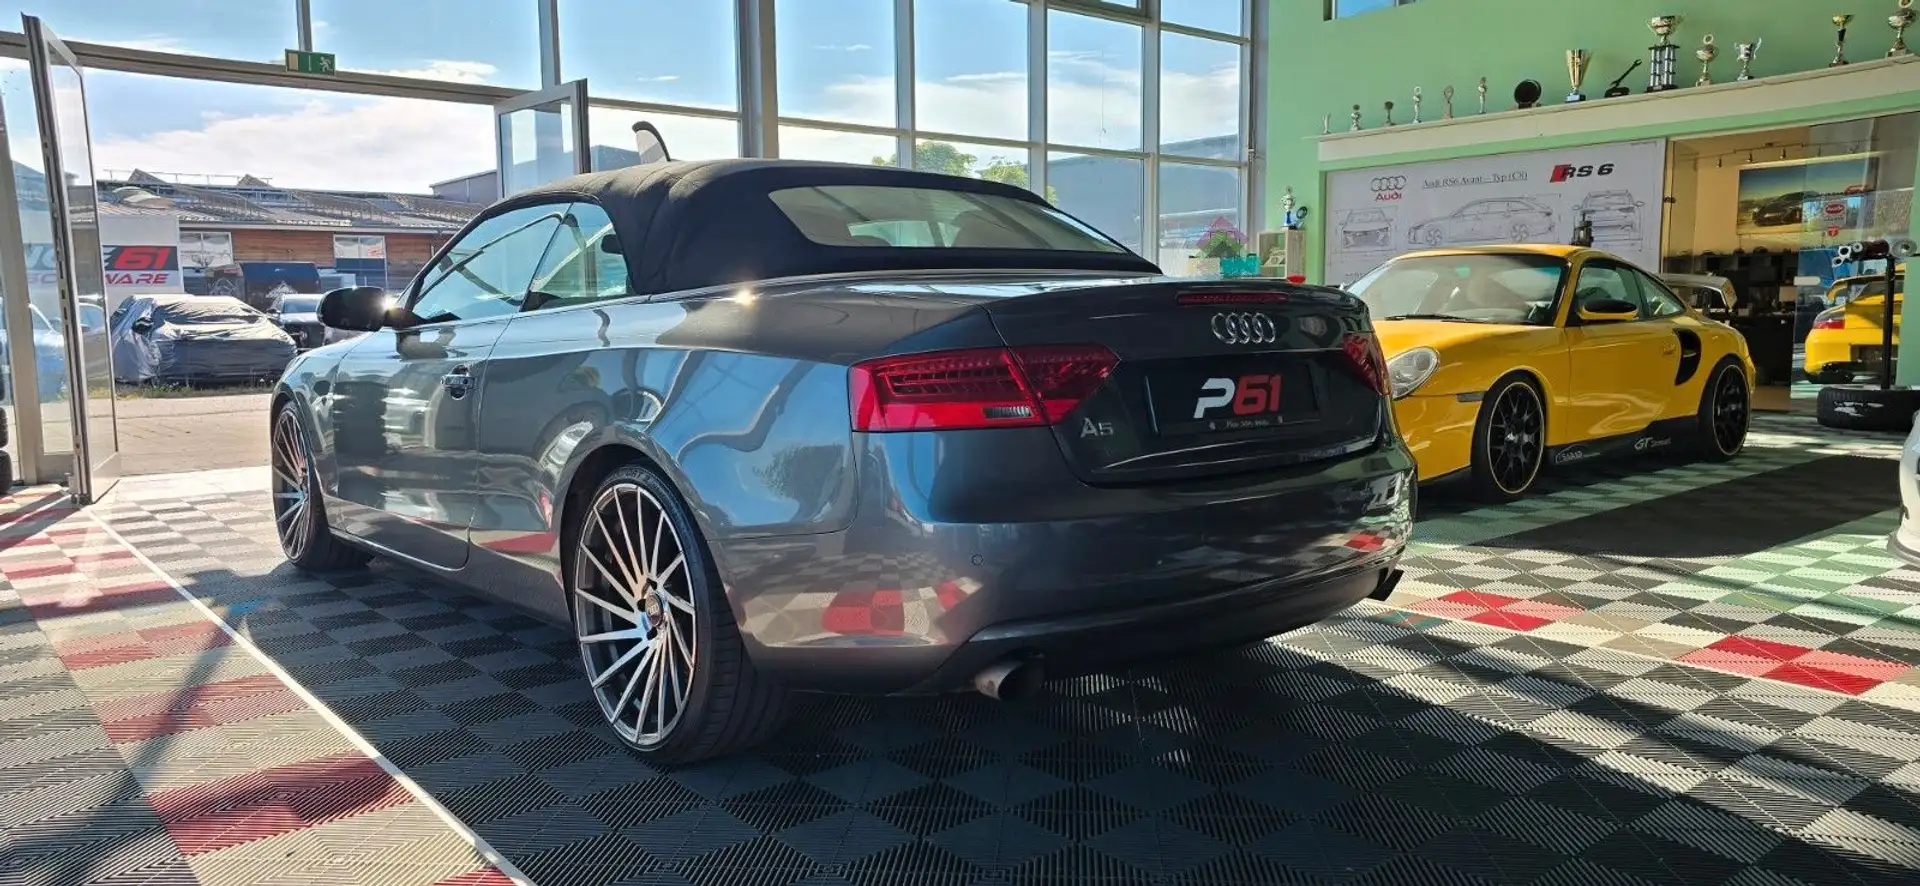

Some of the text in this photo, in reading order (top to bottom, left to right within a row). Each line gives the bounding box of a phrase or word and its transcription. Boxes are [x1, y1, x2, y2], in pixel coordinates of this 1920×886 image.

[1556, 163, 1615, 182] RS 6
[1374, 191, 1402, 202] Audi
[1193, 374, 1282, 419] P61
[1080, 417, 1114, 438] A5
